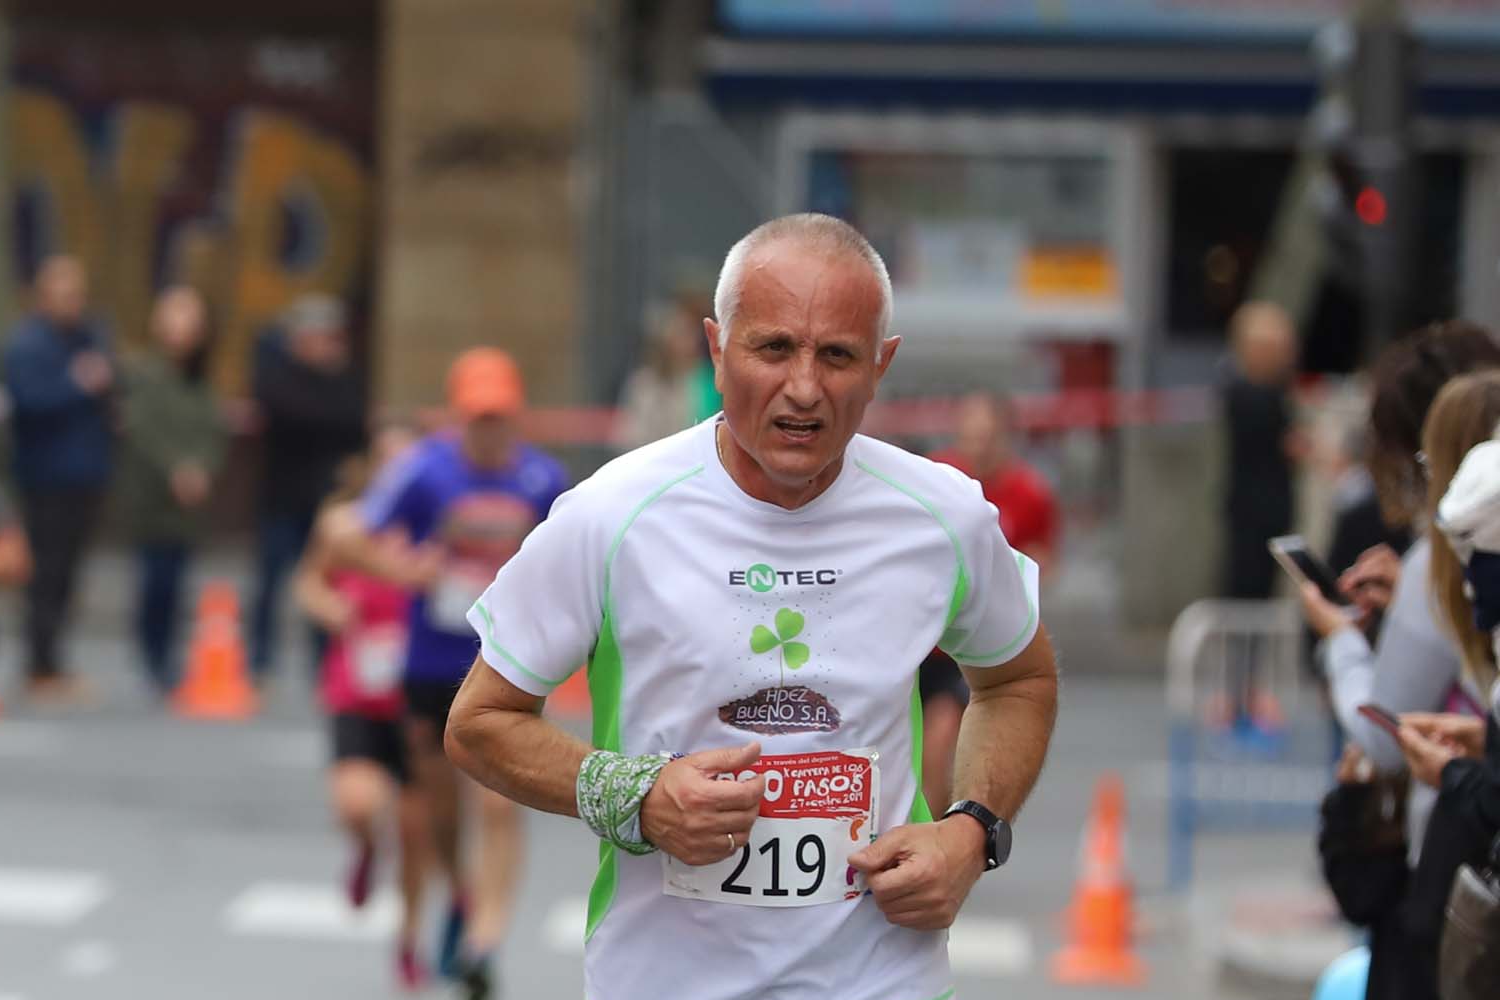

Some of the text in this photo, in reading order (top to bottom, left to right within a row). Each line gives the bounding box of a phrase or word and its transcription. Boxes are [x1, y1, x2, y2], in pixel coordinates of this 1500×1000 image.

[729, 563, 837, 592] ENTEC
[736, 704, 831, 722] BUENO S.A.
[793, 774, 864, 797] PASOS
[790, 798, 805, 809] 27
[721, 833, 827, 897] 219
